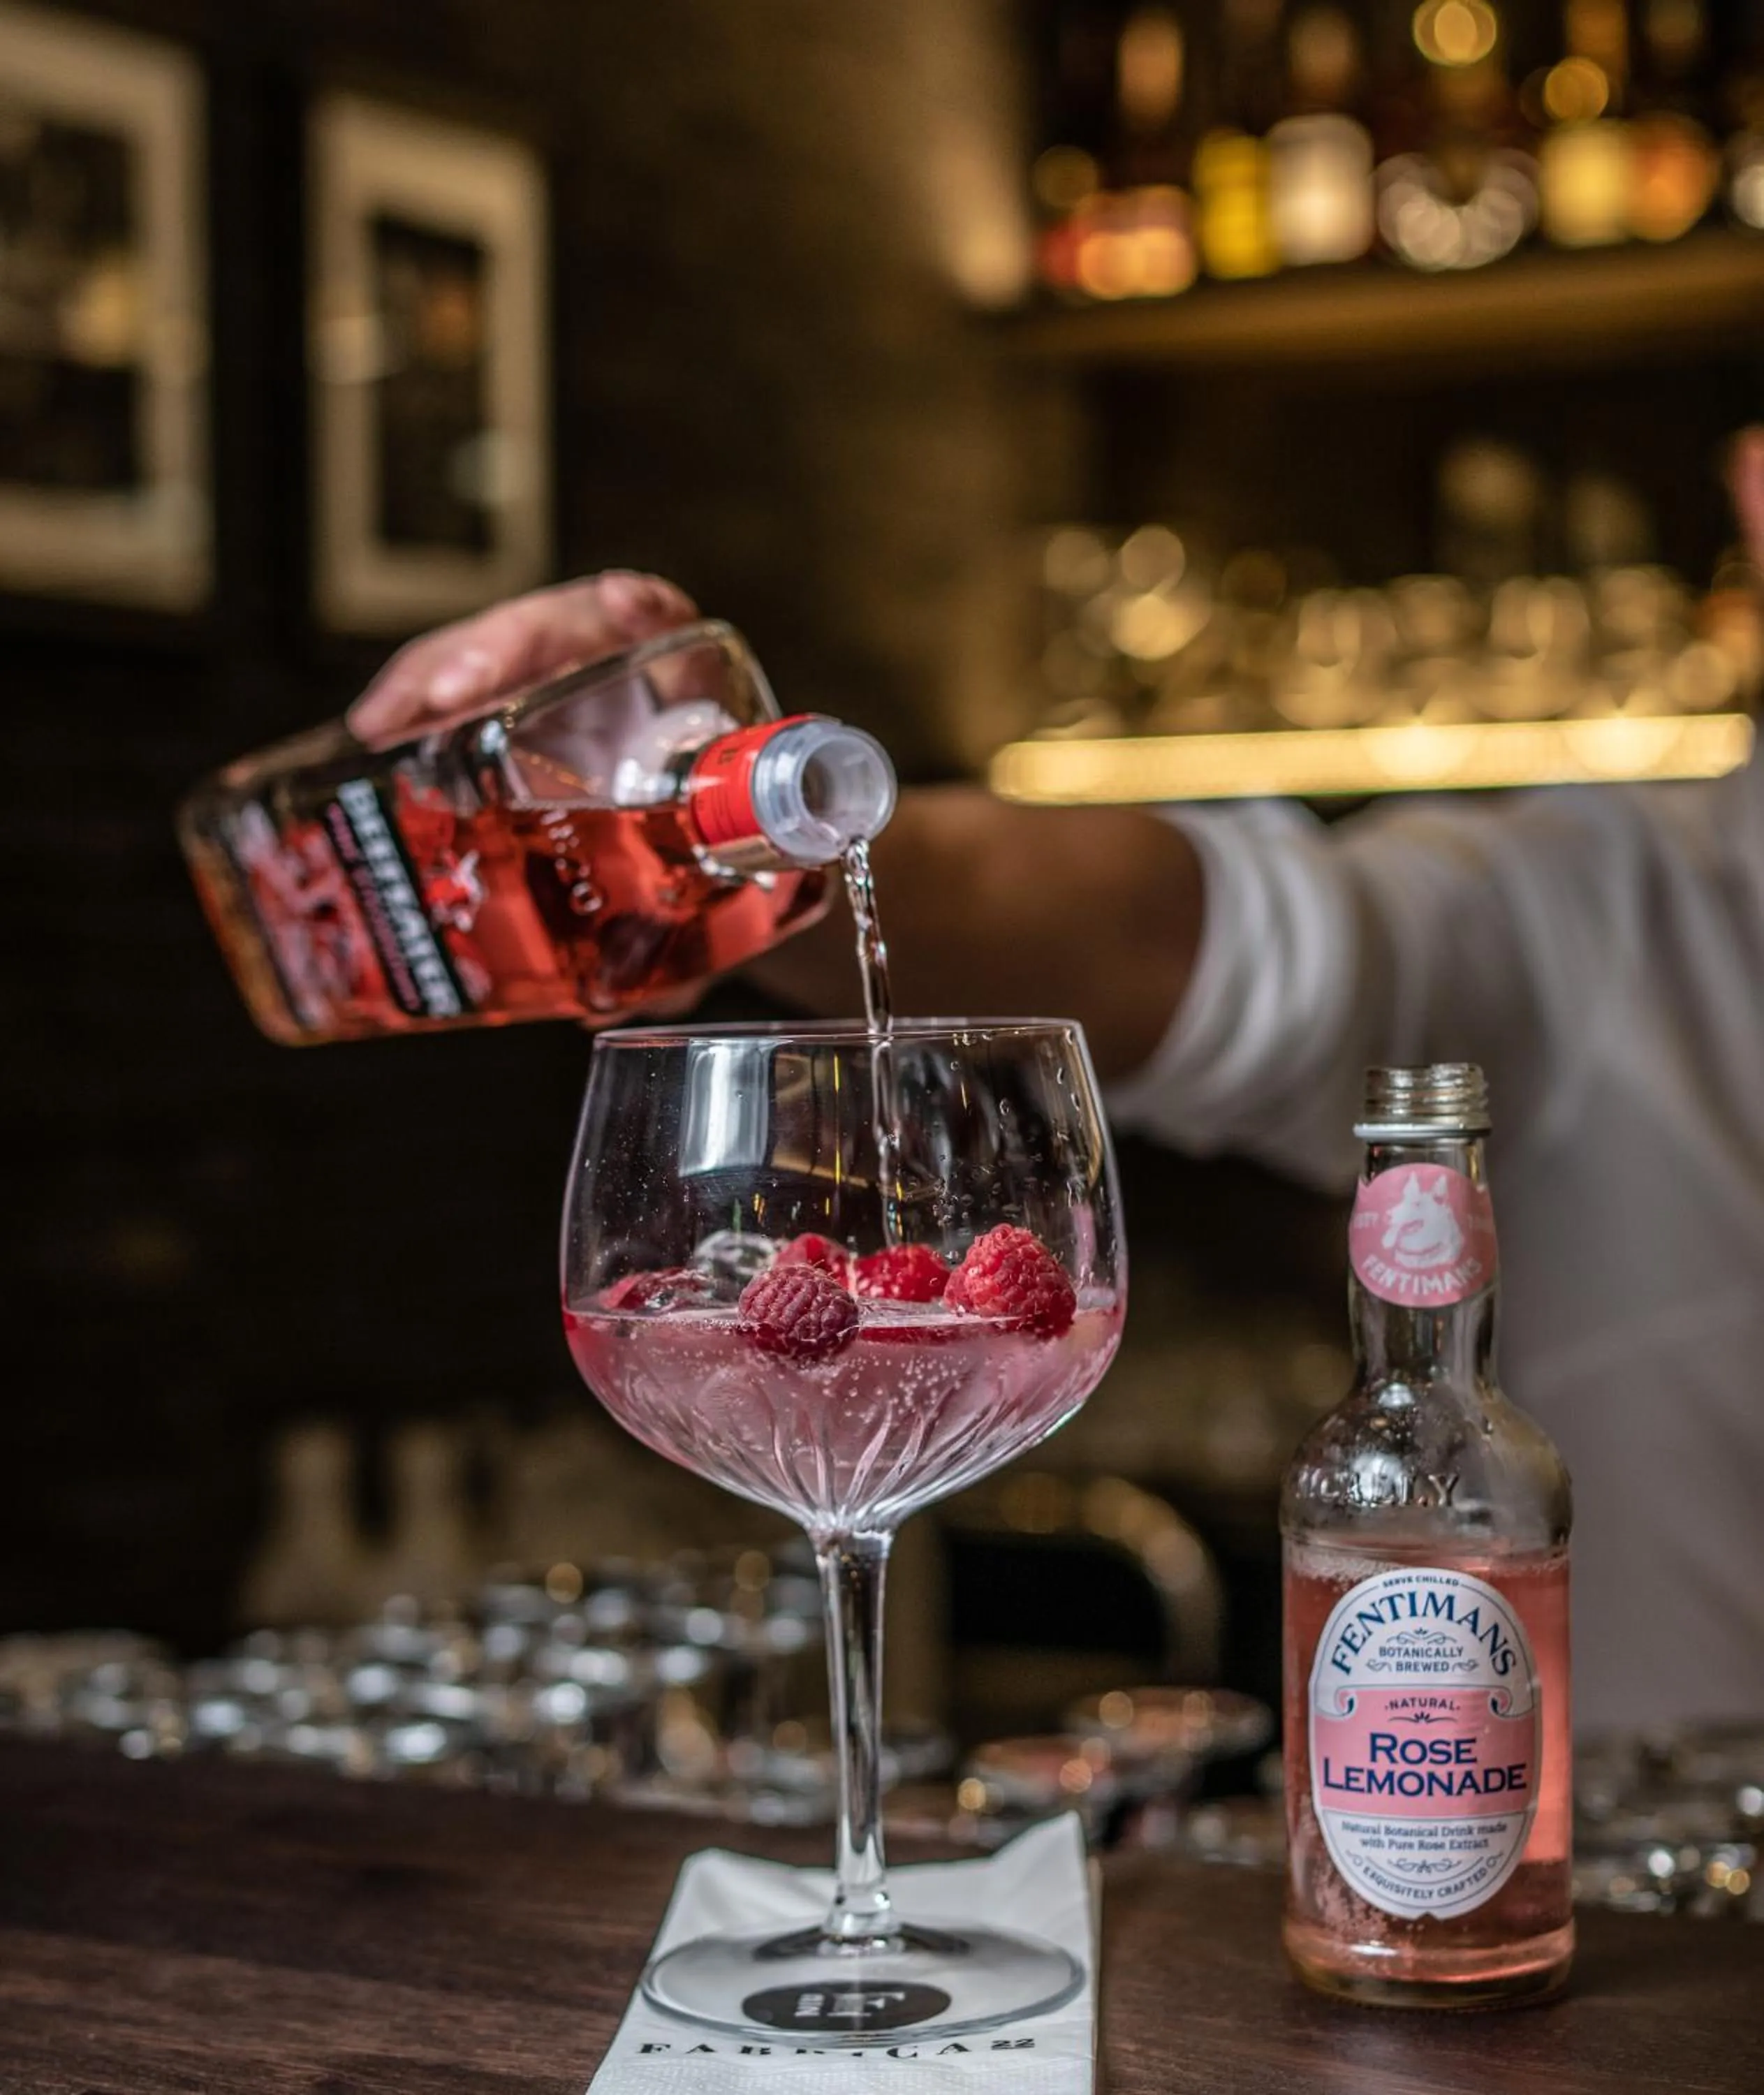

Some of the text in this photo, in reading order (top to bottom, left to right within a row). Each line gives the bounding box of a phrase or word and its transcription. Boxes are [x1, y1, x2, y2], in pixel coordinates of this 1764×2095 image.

[1416, 1575, 1460, 1587] CHILLED
[1331, 1591, 1517, 1677] FENTIMANS
[1379, 1646, 1464, 1658] BOTANICALLY
[1395, 1661, 1450, 1673] BREWED
[1389, 1697, 1455, 1711] NATURAL
[1369, 1733, 1478, 1765] ROSE
[1323, 1757, 1527, 1797] LEMONADE
[1342, 1821, 1507, 1837] Natural Botanical Drink made
[1360, 1837, 1490, 1851] with Pure Rose Extract
[1362, 1866, 1487, 1899] EXQUISITELY CRAFTED
